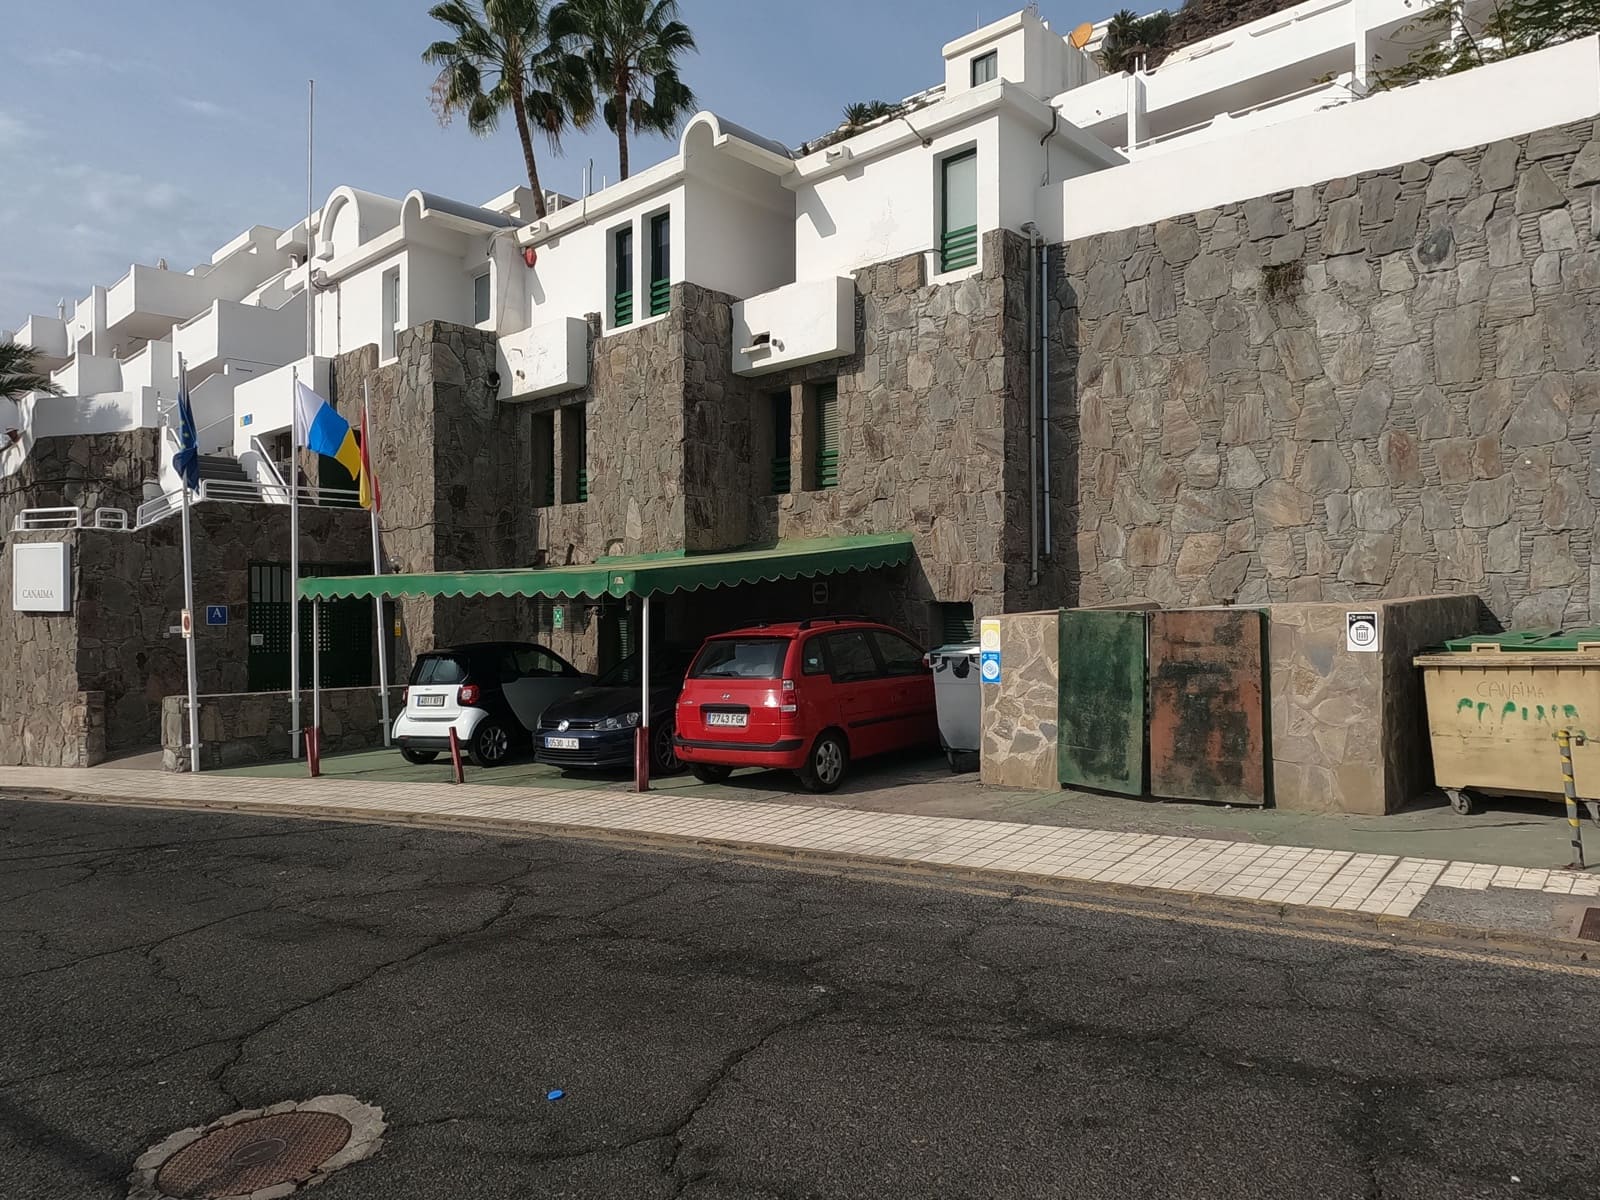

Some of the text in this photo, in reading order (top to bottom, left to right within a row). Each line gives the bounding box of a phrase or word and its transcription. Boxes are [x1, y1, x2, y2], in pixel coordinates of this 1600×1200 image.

[22, 589, 54, 599] CANAIMA
[212, 607, 222, 618] A
[711, 714, 730, 724] 7743
